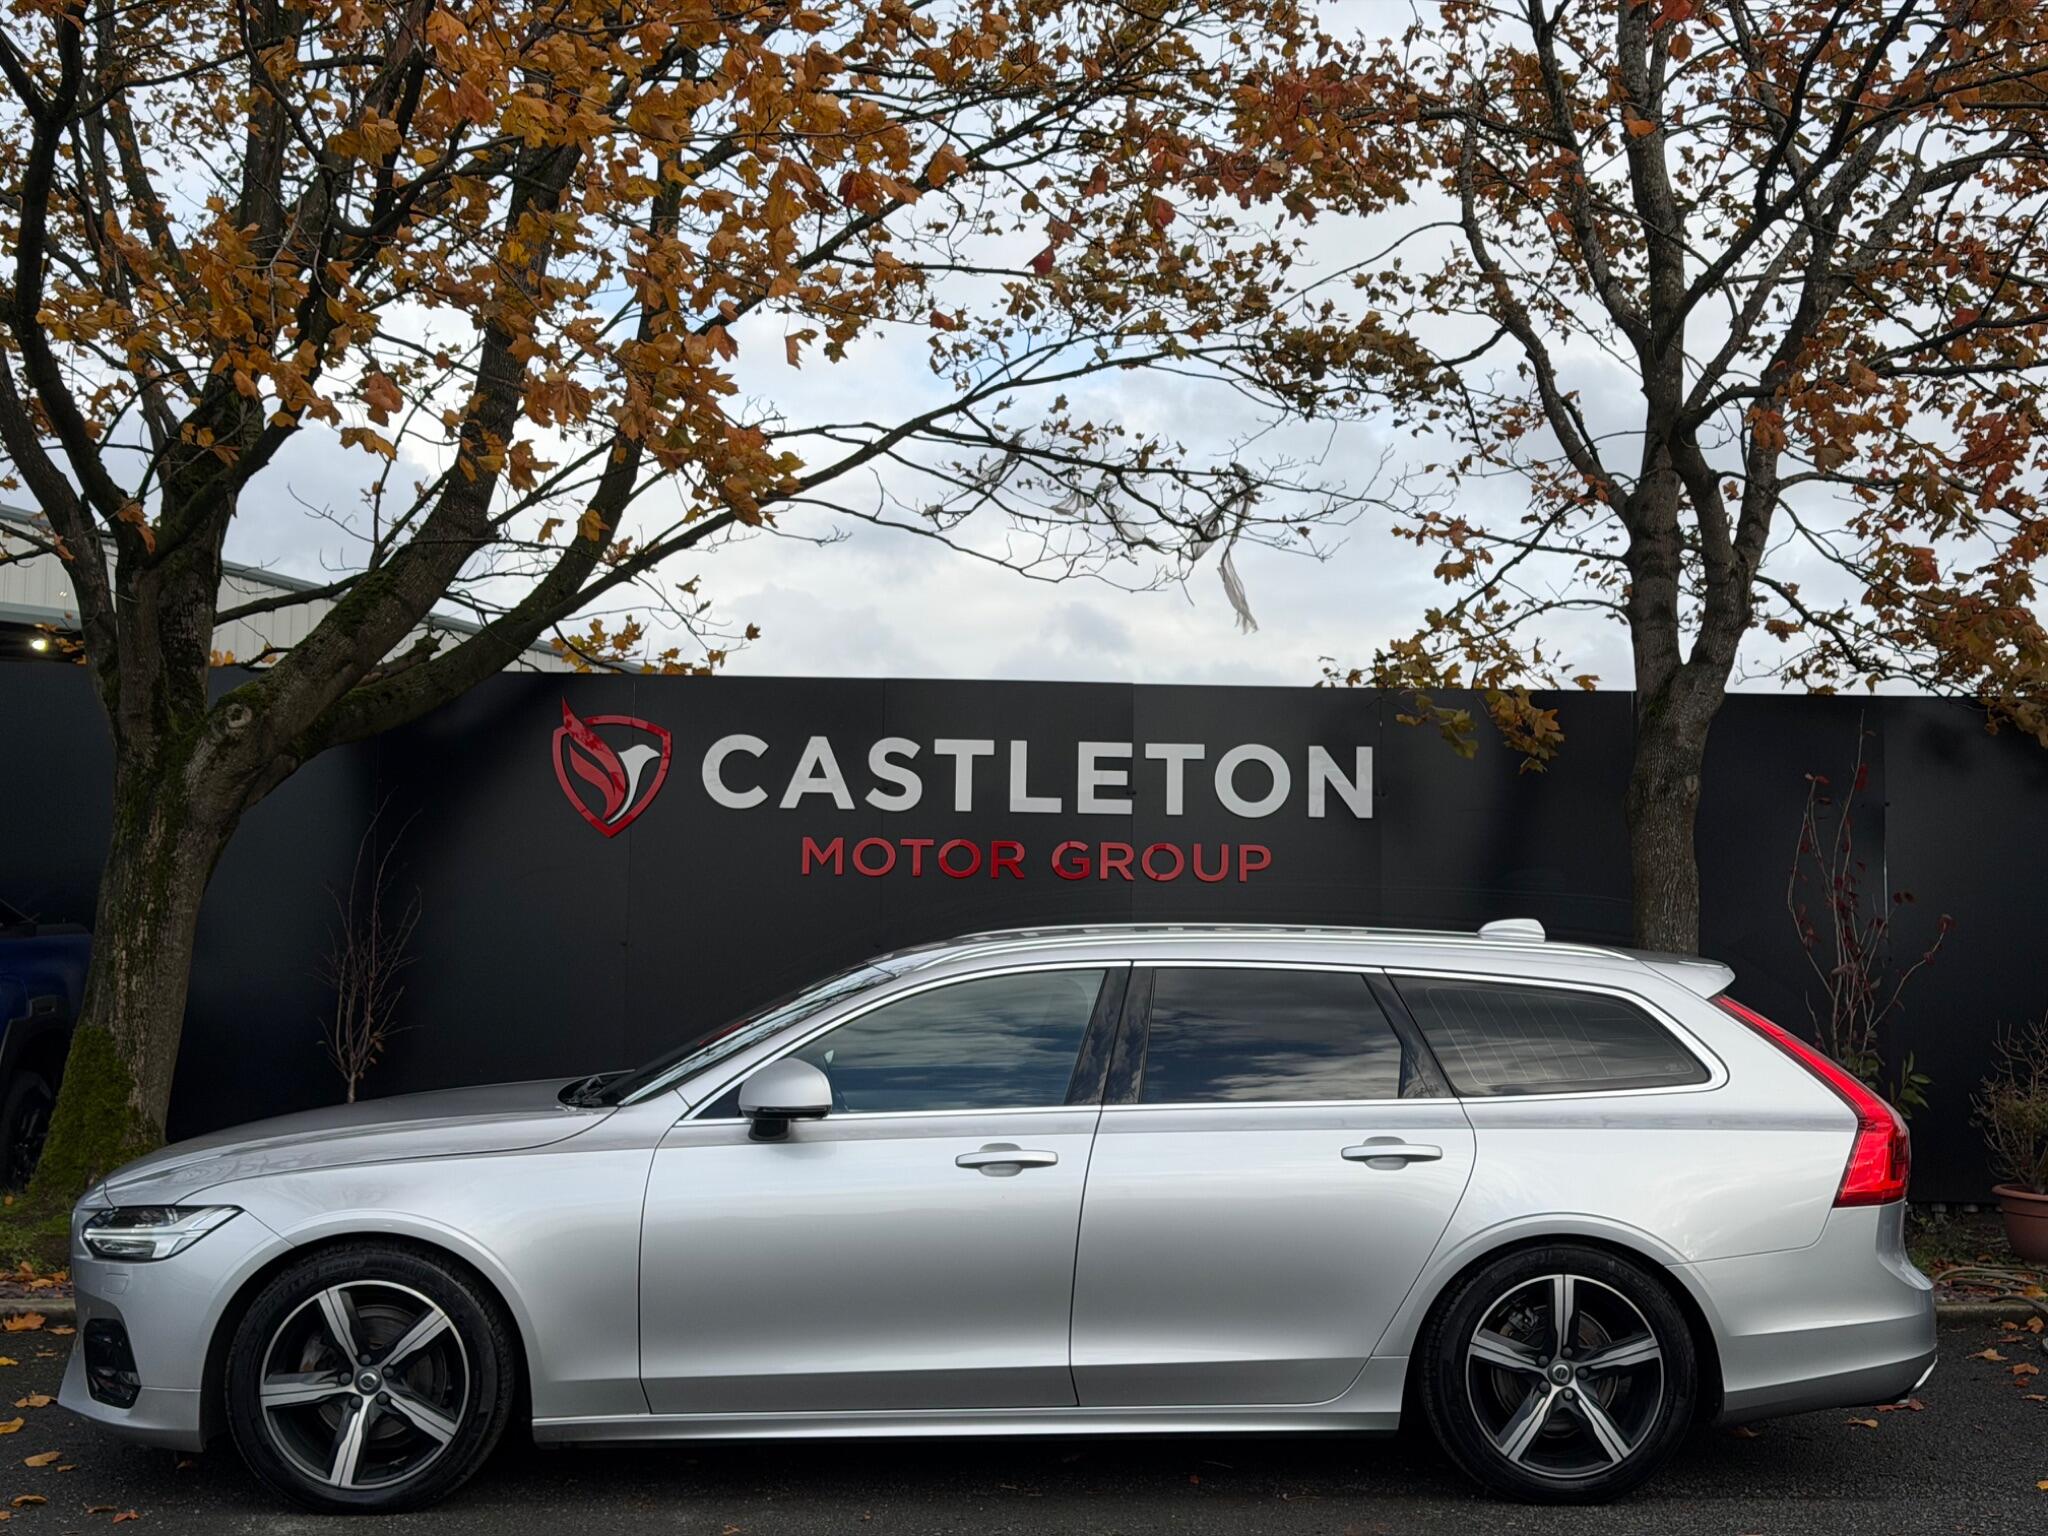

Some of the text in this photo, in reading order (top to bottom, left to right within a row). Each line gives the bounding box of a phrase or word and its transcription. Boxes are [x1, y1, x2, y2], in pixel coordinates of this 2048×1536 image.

[702, 734, 1373, 819] CASTLETON
[801, 836, 1272, 883] MOTOR GROUP
